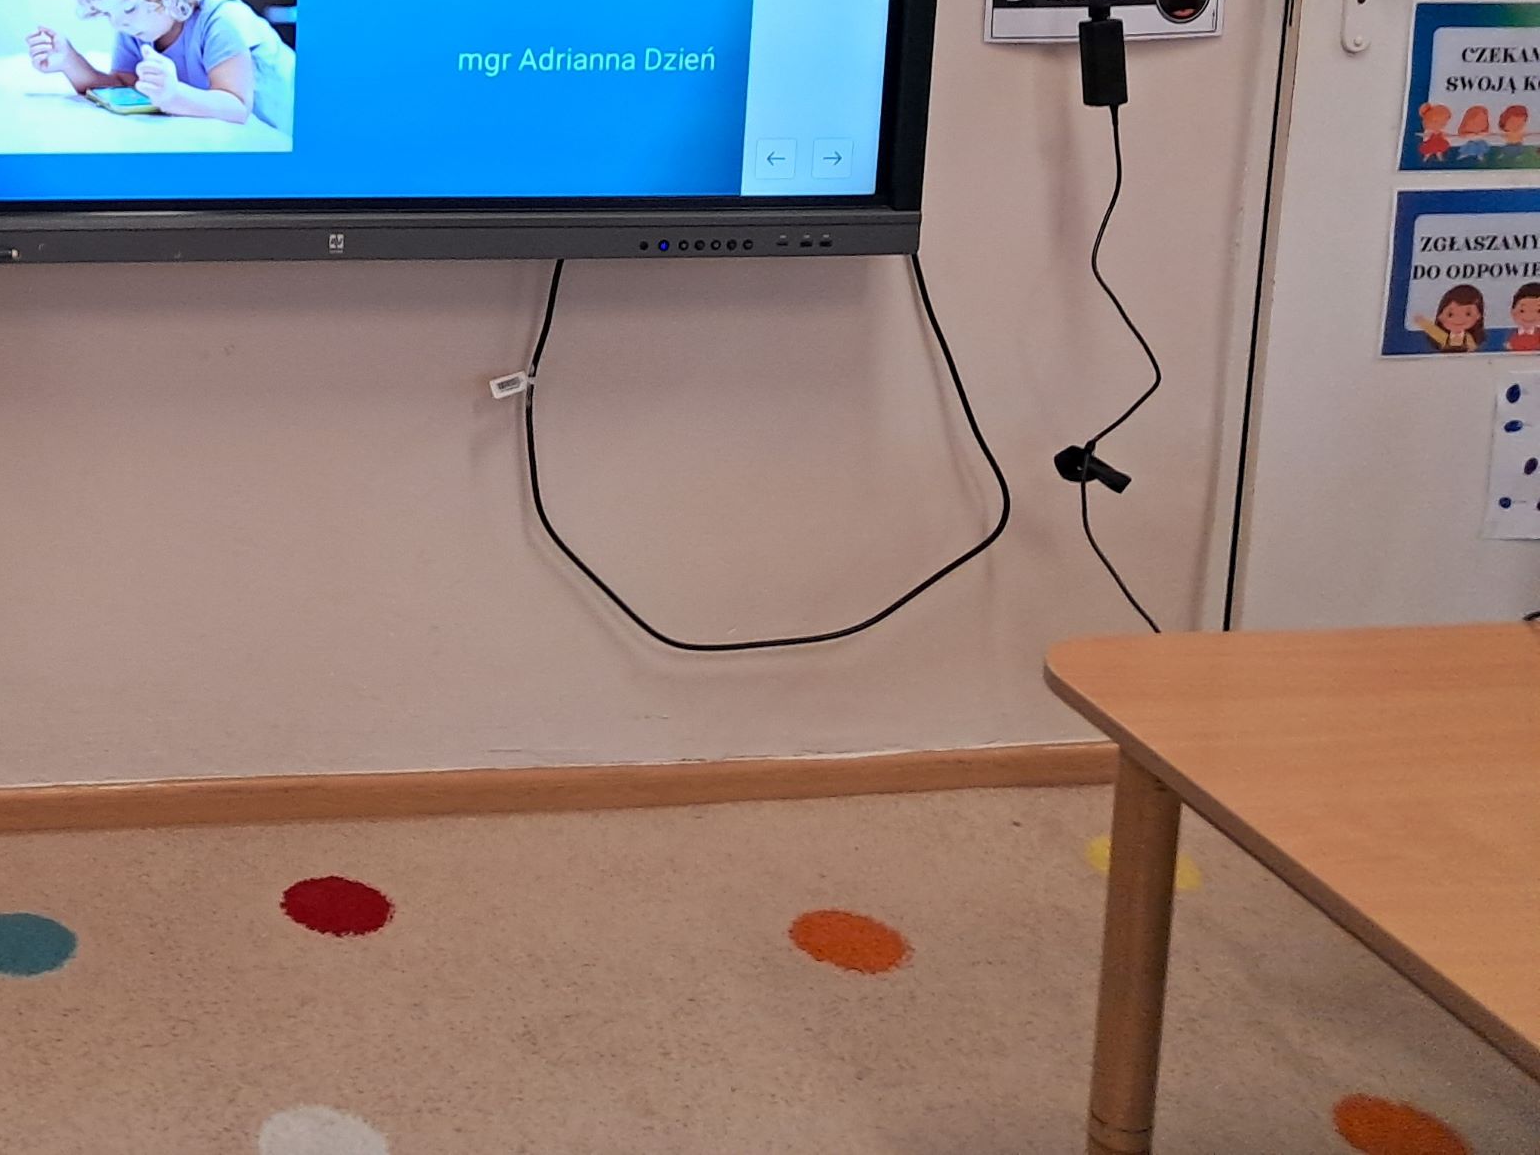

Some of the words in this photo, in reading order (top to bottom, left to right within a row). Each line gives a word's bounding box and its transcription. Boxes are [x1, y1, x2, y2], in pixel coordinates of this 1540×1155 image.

[458, 52, 512, 77] mgr
[519, 47, 636, 72] Adrianna
[644, 46, 715, 72] Dzień
[1445, 76, 1516, 94] SWOJĄ
[1523, 76, 1540, 91] K
[1412, 263, 1441, 281] DO
